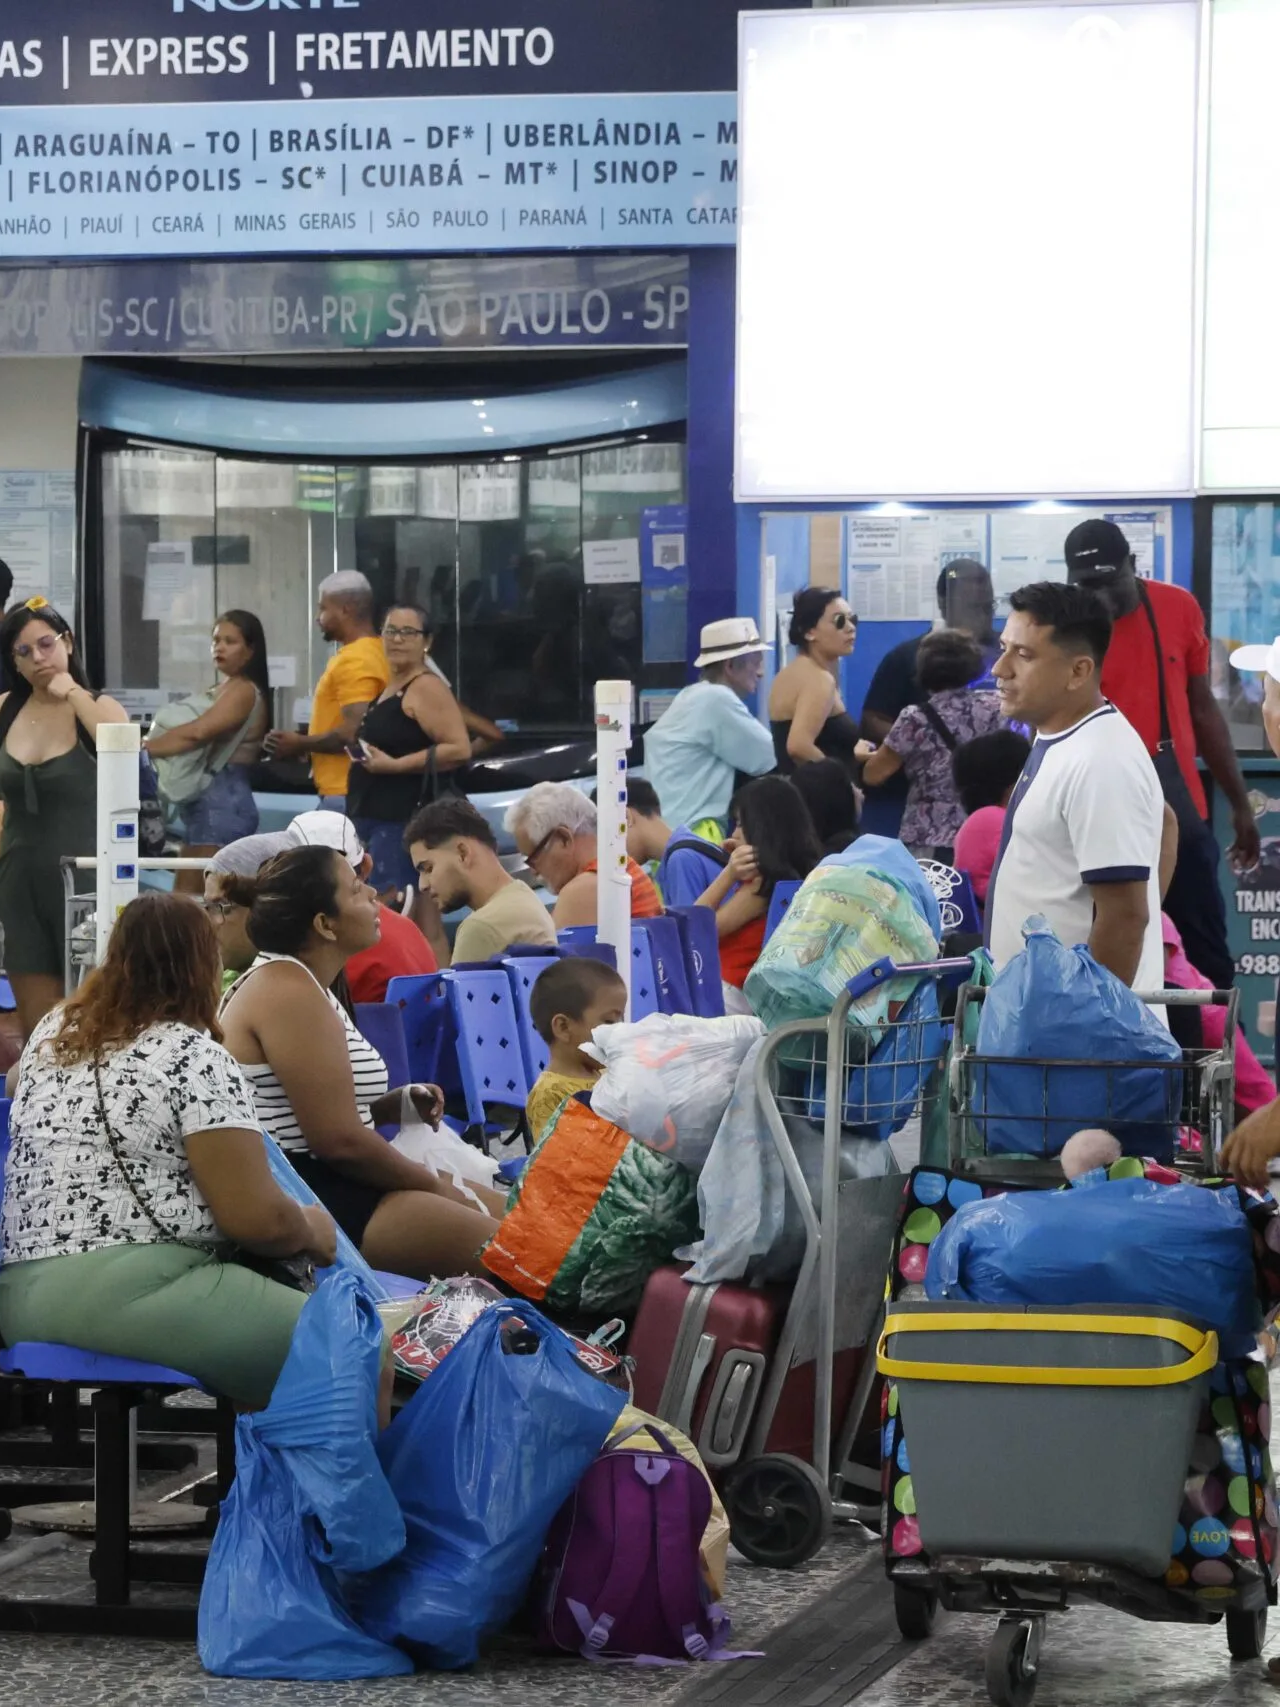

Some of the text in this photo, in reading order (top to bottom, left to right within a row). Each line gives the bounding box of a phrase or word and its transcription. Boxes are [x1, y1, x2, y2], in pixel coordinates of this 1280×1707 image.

[89, 34, 249, 77] EXPRESS
[296, 26, 554, 72] FRETAMENTO
[14, 128, 173, 158] ARAGUAÍNA
[205, 130, 240, 154] TO
[269, 122, 392, 153] BRASÍLIA
[504, 117, 681, 148] UBERLÂNDIA
[28, 164, 241, 195] FLORIANÓPOLIS
[361, 157, 464, 189] CUIABÁ
[594, 160, 678, 185] SINOP
[80, 213, 123, 234] PIAUÍ
[151, 212, 205, 234] CEARÁ
[234, 213, 287, 232] MINAS
[299, 212, 357, 231] GERAIS
[386, 207, 420, 229] SÃO
[432, 209, 489, 228] PAULO
[519, 205, 587, 227] PARANÁ
[618, 207, 673, 226] SANTA
[479, 289, 610, 335] PAULO
[642, 284, 688, 331] SP
